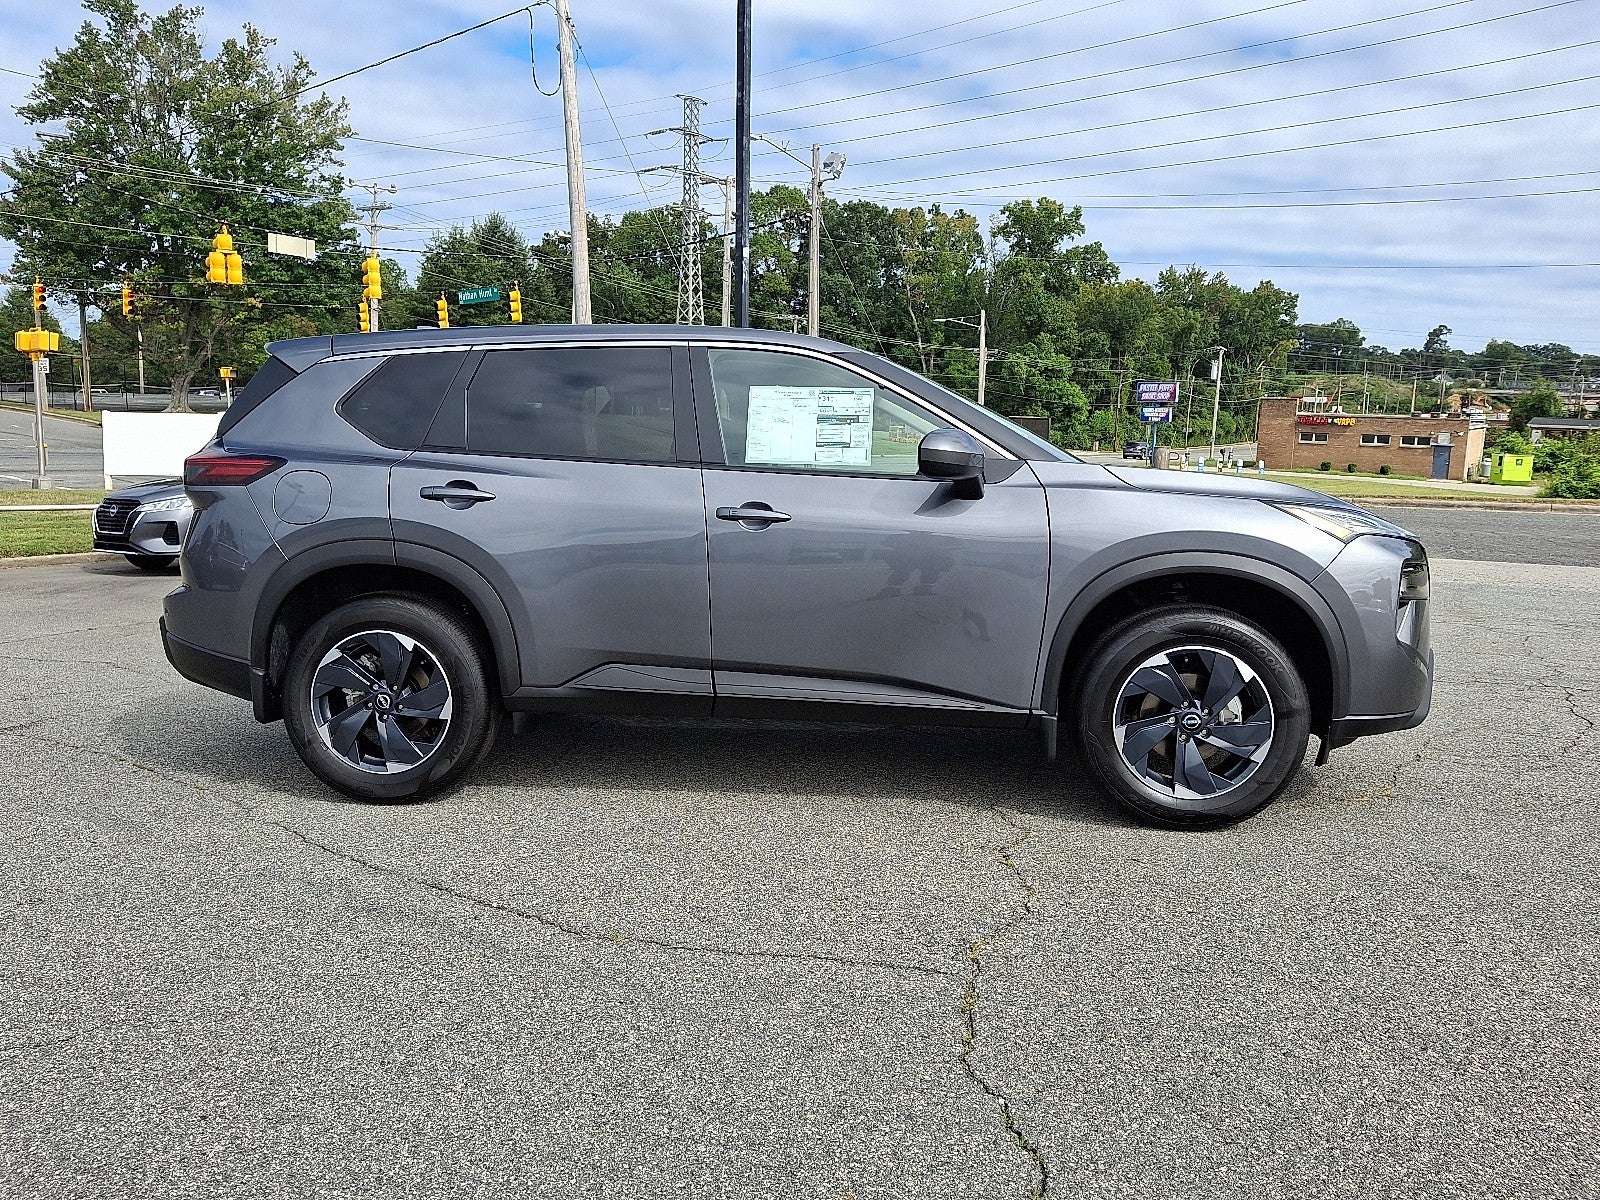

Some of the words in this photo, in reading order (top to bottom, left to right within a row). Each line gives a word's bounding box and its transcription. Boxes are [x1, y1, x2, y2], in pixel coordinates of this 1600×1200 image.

[458, 291, 478, 301] Nathan
[478, 288, 493, 299] Hunt
[1337, 417, 1356, 426] VAPE
